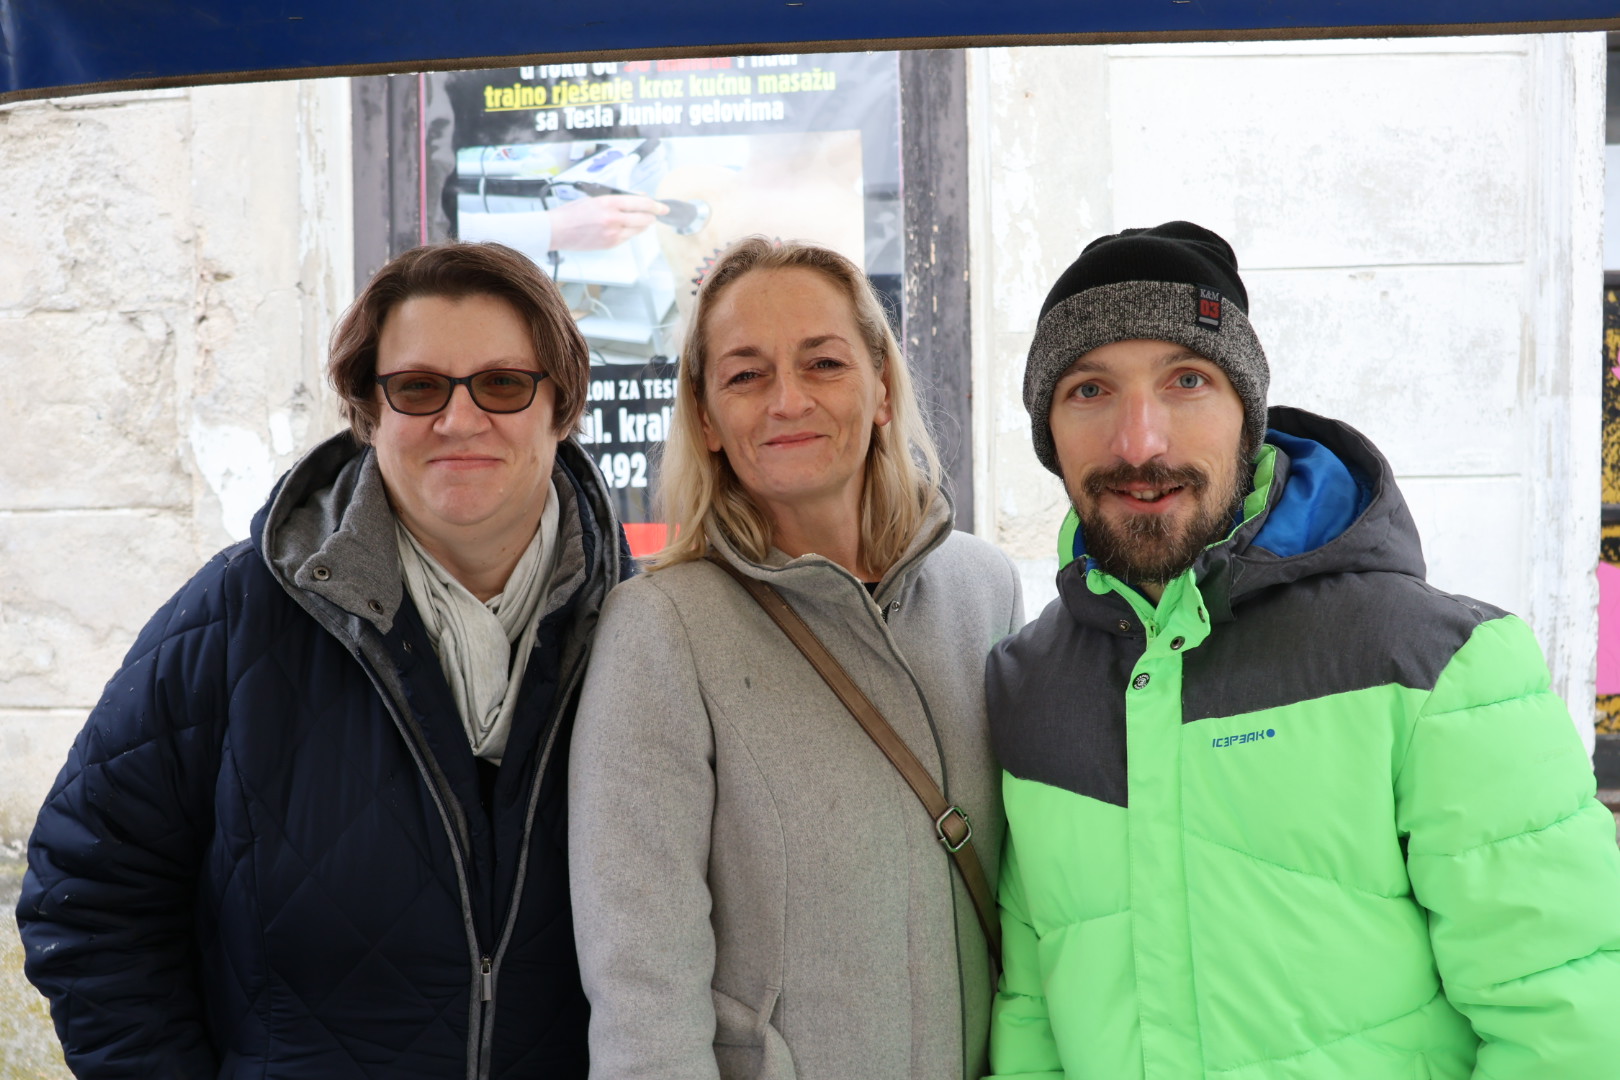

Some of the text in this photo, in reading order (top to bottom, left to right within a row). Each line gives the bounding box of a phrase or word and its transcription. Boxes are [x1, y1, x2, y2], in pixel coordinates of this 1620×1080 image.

[484, 68, 836, 109] trajno rješenje kroz kućnu masažu
[535, 98, 785, 131] sa Tesla Junior gelovima
[1200, 288, 1220, 301] K&M
[1200, 299, 1221, 319] 03
[618, 379, 640, 400] ZA
[618, 406, 674, 443] kral
